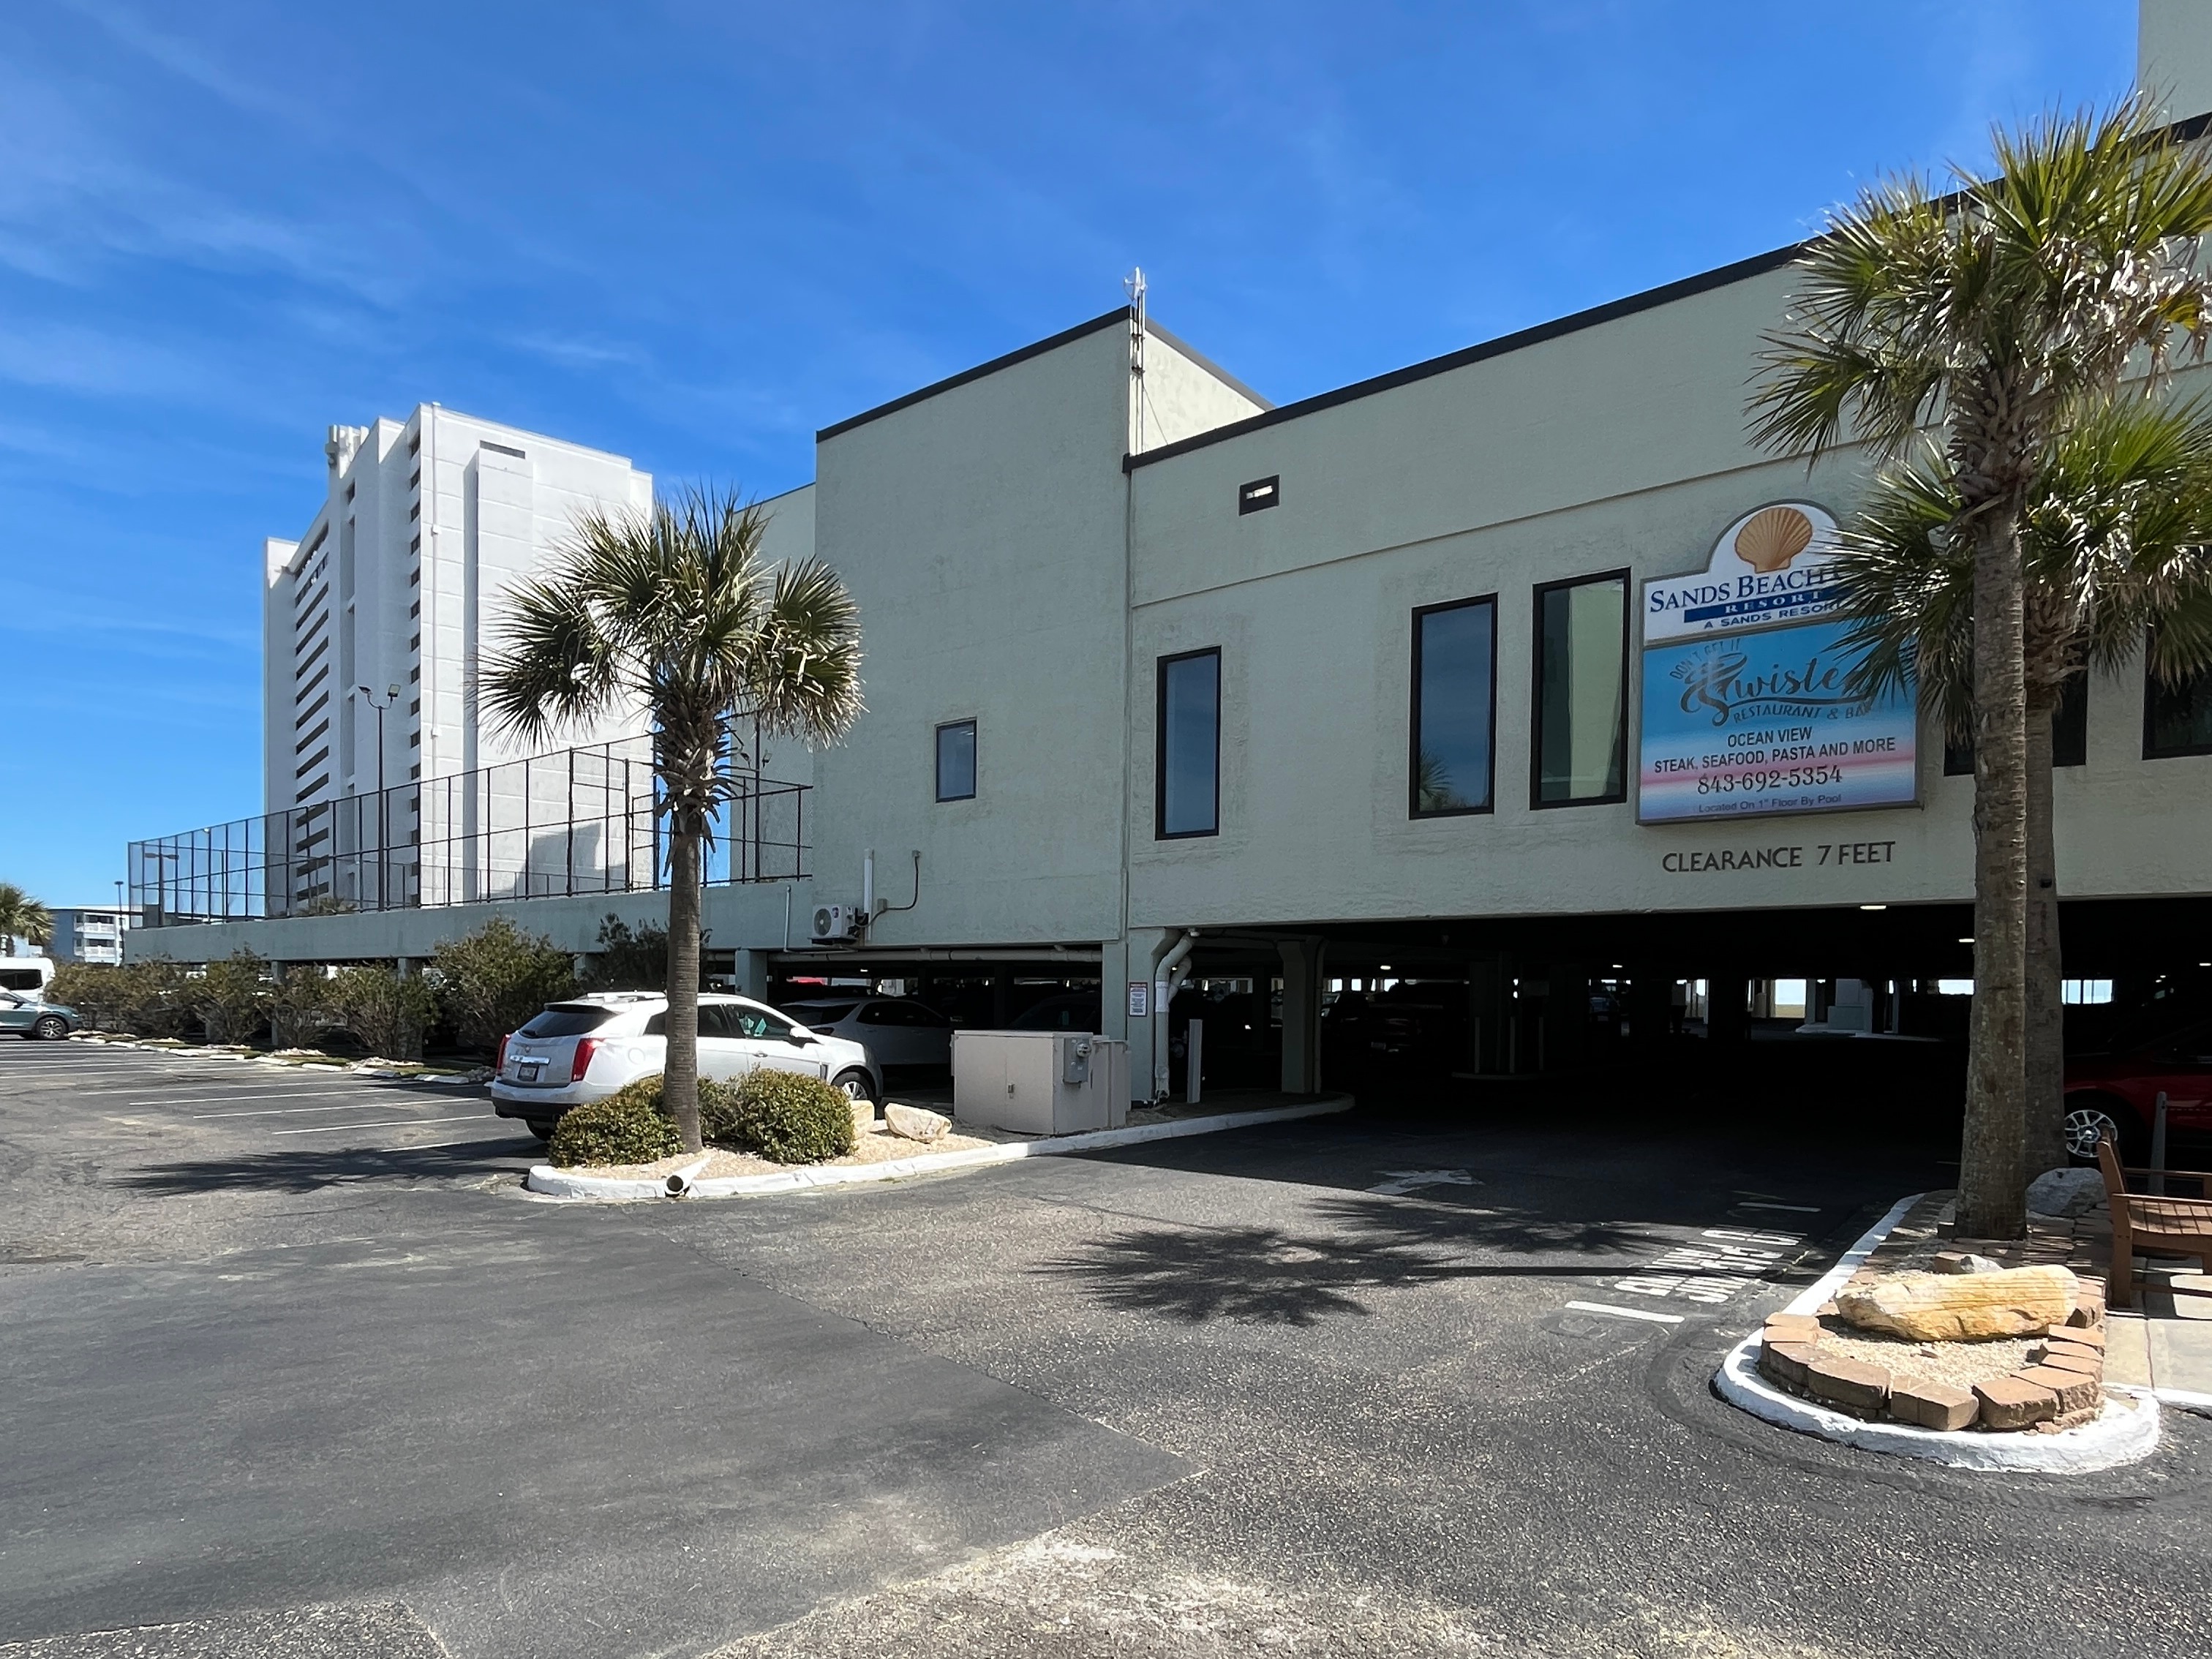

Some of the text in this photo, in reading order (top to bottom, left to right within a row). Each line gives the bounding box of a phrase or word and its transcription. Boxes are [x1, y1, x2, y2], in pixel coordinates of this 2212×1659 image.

[1649, 582, 1730, 613] SANDS
[1737, 568, 1826, 599] BEACH
[1725, 591, 1822, 614] RESORT
[1704, 621, 1714, 629] A
[1721, 612, 1772, 627] SANDS
[1734, 701, 1871, 724] RESTAURANT & BA
[1727, 726, 1813, 748] OCEAN VIEW
[1654, 737, 1896, 772] STEAK, SEAFOOD, PASTA AND MORE
[1696, 764, 1843, 794] 843-692-5354
[1698, 802, 1737, 813] Located
[1740, 801, 1755, 810] On
[1772, 798, 1798, 808] Floor
[1801, 796, 1815, 806] By
[1818, 794, 1842, 804] Pool
[1662, 841, 1896, 873] CLEARANCE 7 FEET
